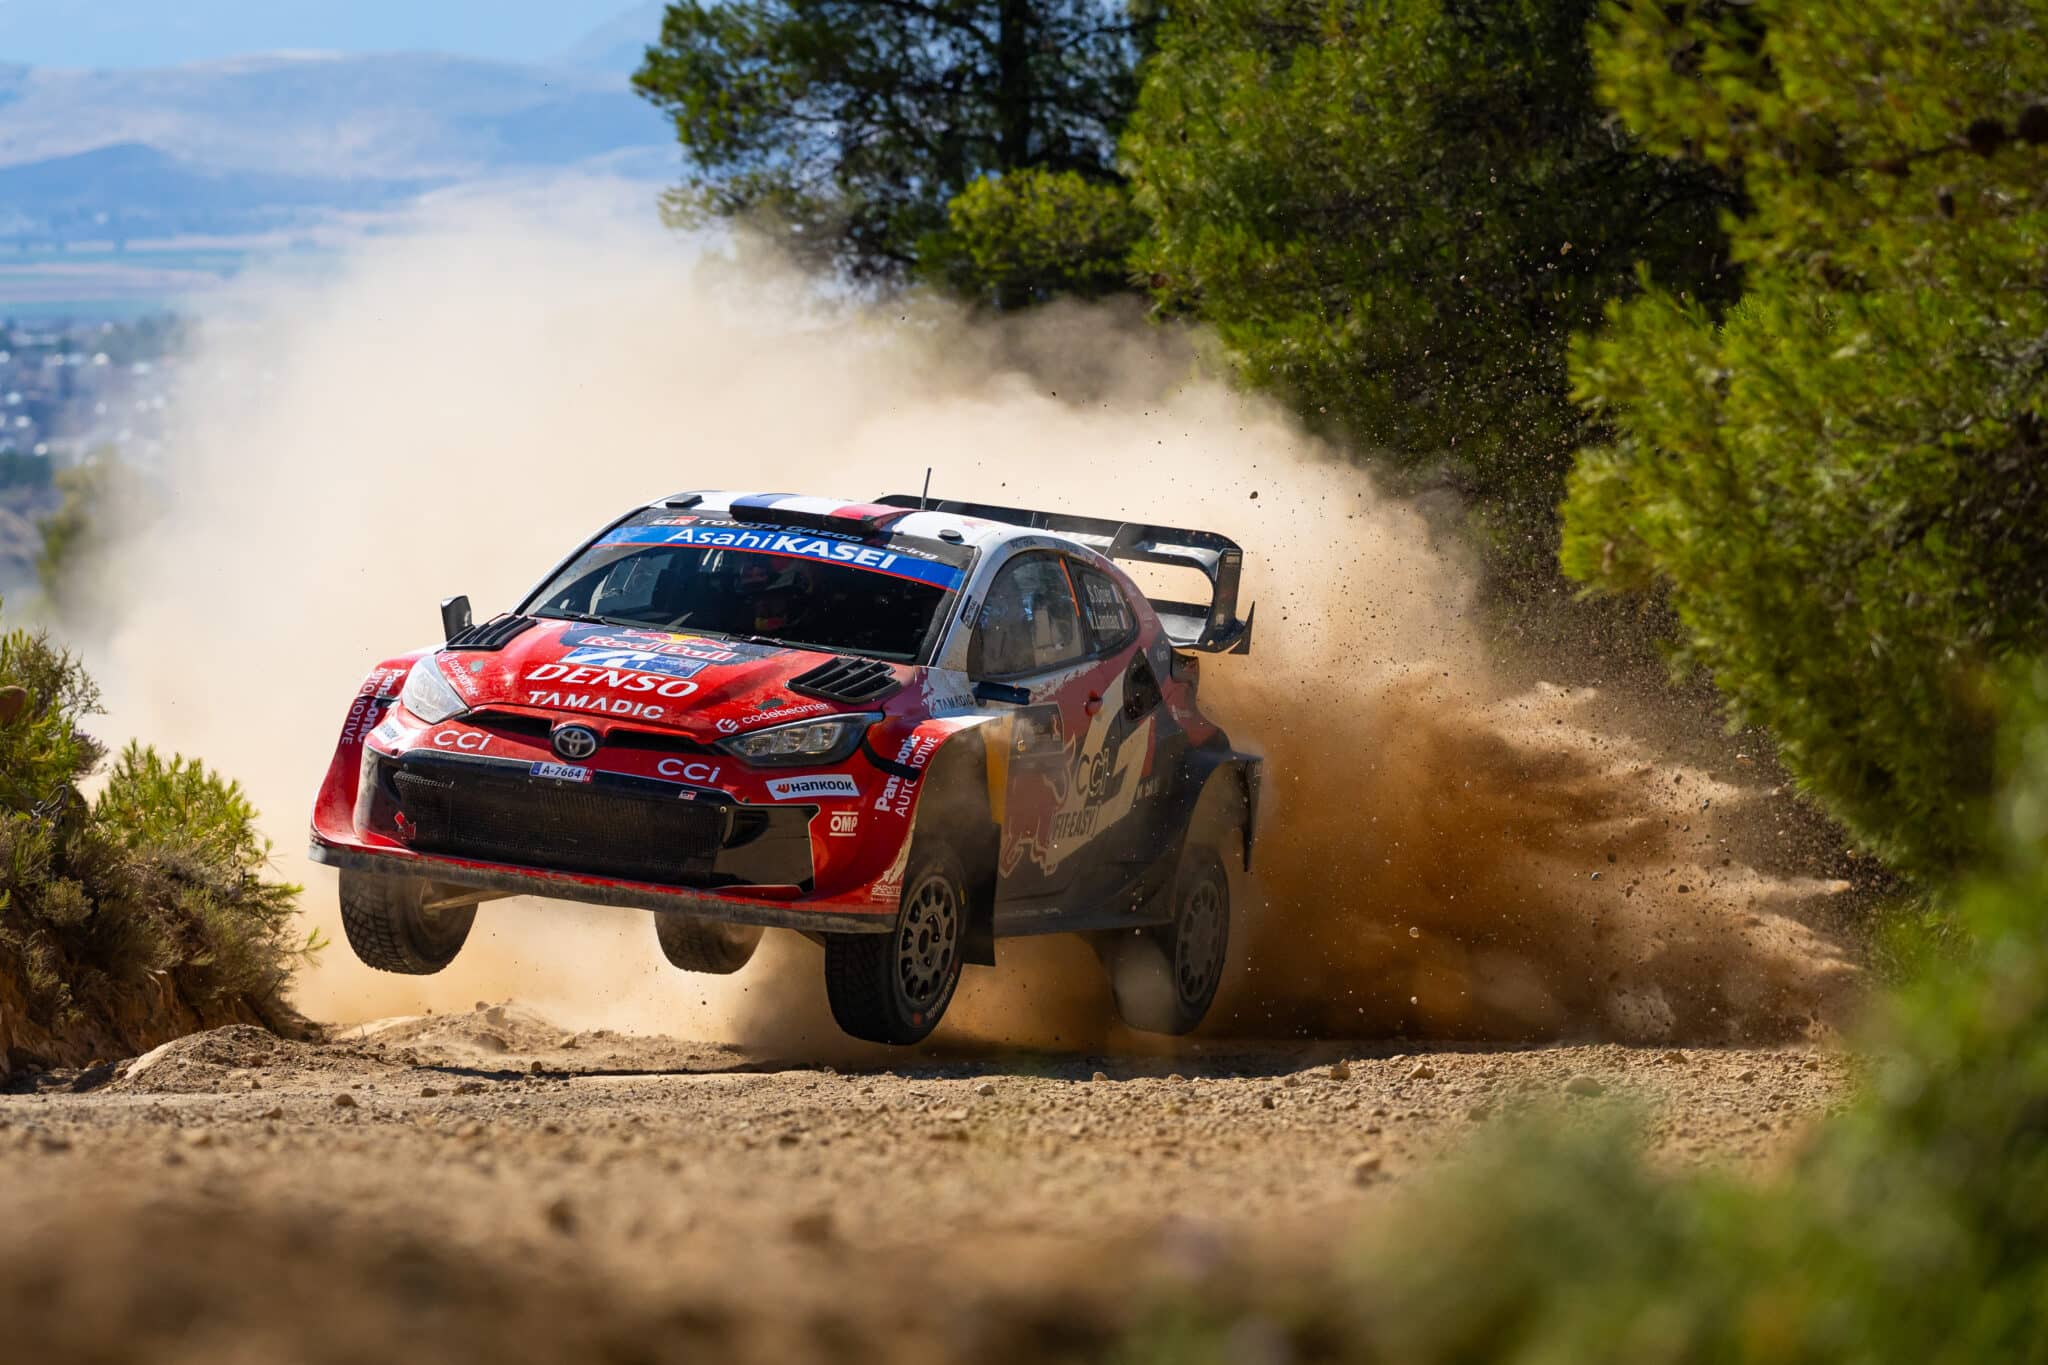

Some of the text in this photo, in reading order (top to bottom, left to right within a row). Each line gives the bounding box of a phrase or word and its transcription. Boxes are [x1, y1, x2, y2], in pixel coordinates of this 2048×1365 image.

[699, 519, 781, 531] TOYOTA
[785, 525, 864, 542] GAZOO
[666, 528, 897, 569] AsahiKASEI
[578, 635, 739, 662] Red Bull
[525, 664, 698, 698] DENSO
[528, 690, 665, 719] TAMADIC
[742, 702, 829, 725] codebeamer
[542, 765, 582, 779] A-7664
[874, 734, 921, 812] Pansonic
[830, 815, 858, 832] OMP
